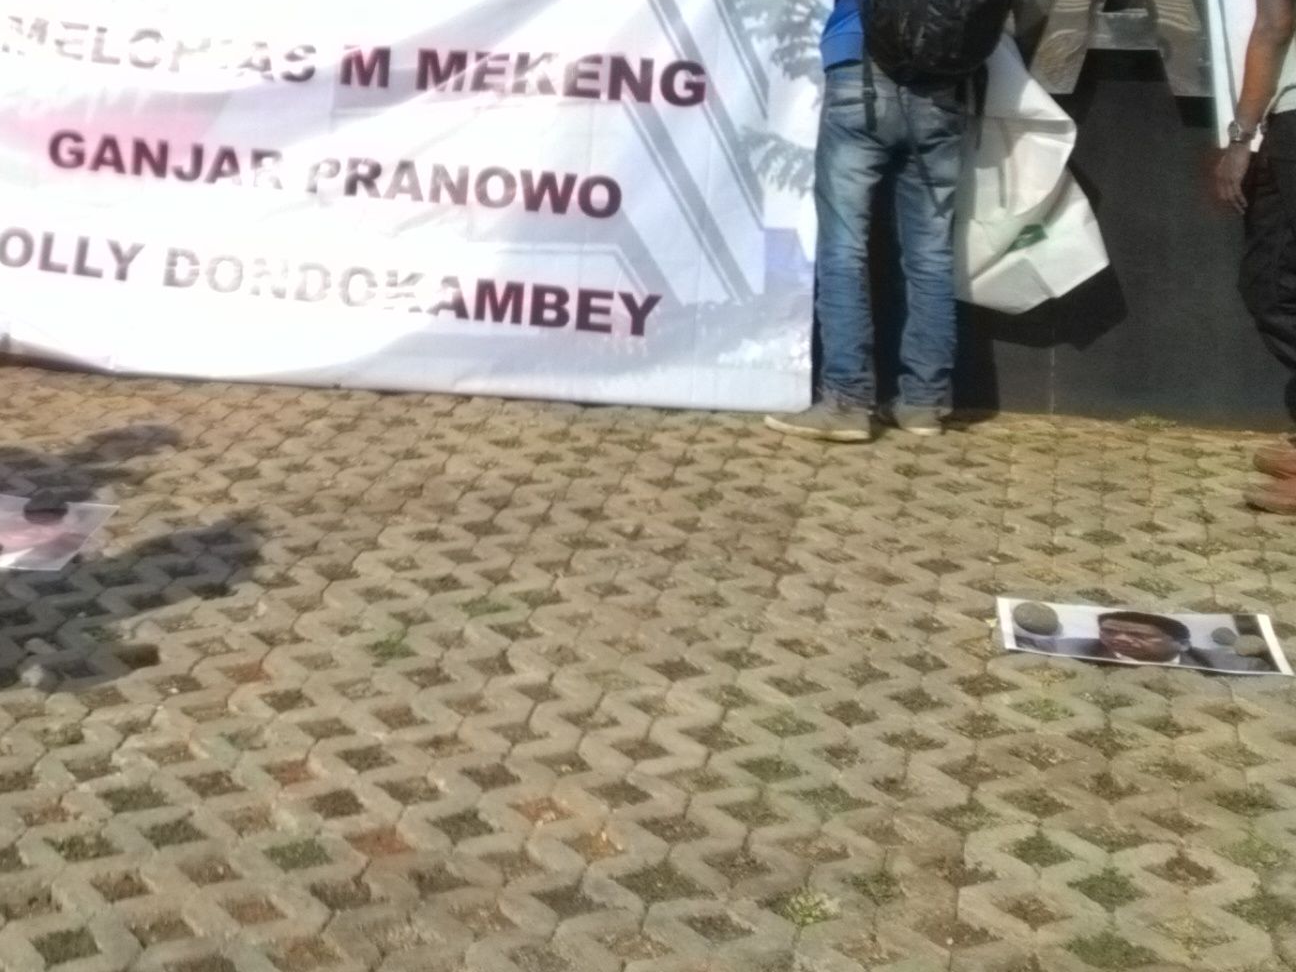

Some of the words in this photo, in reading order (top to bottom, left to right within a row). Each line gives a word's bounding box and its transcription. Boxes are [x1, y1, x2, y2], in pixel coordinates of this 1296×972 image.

[339, 44, 392, 89] M
[414, 47, 707, 107] MEKENG
[47, 128, 284, 191] GANJAR
[304, 156, 623, 219] PRANOWO
